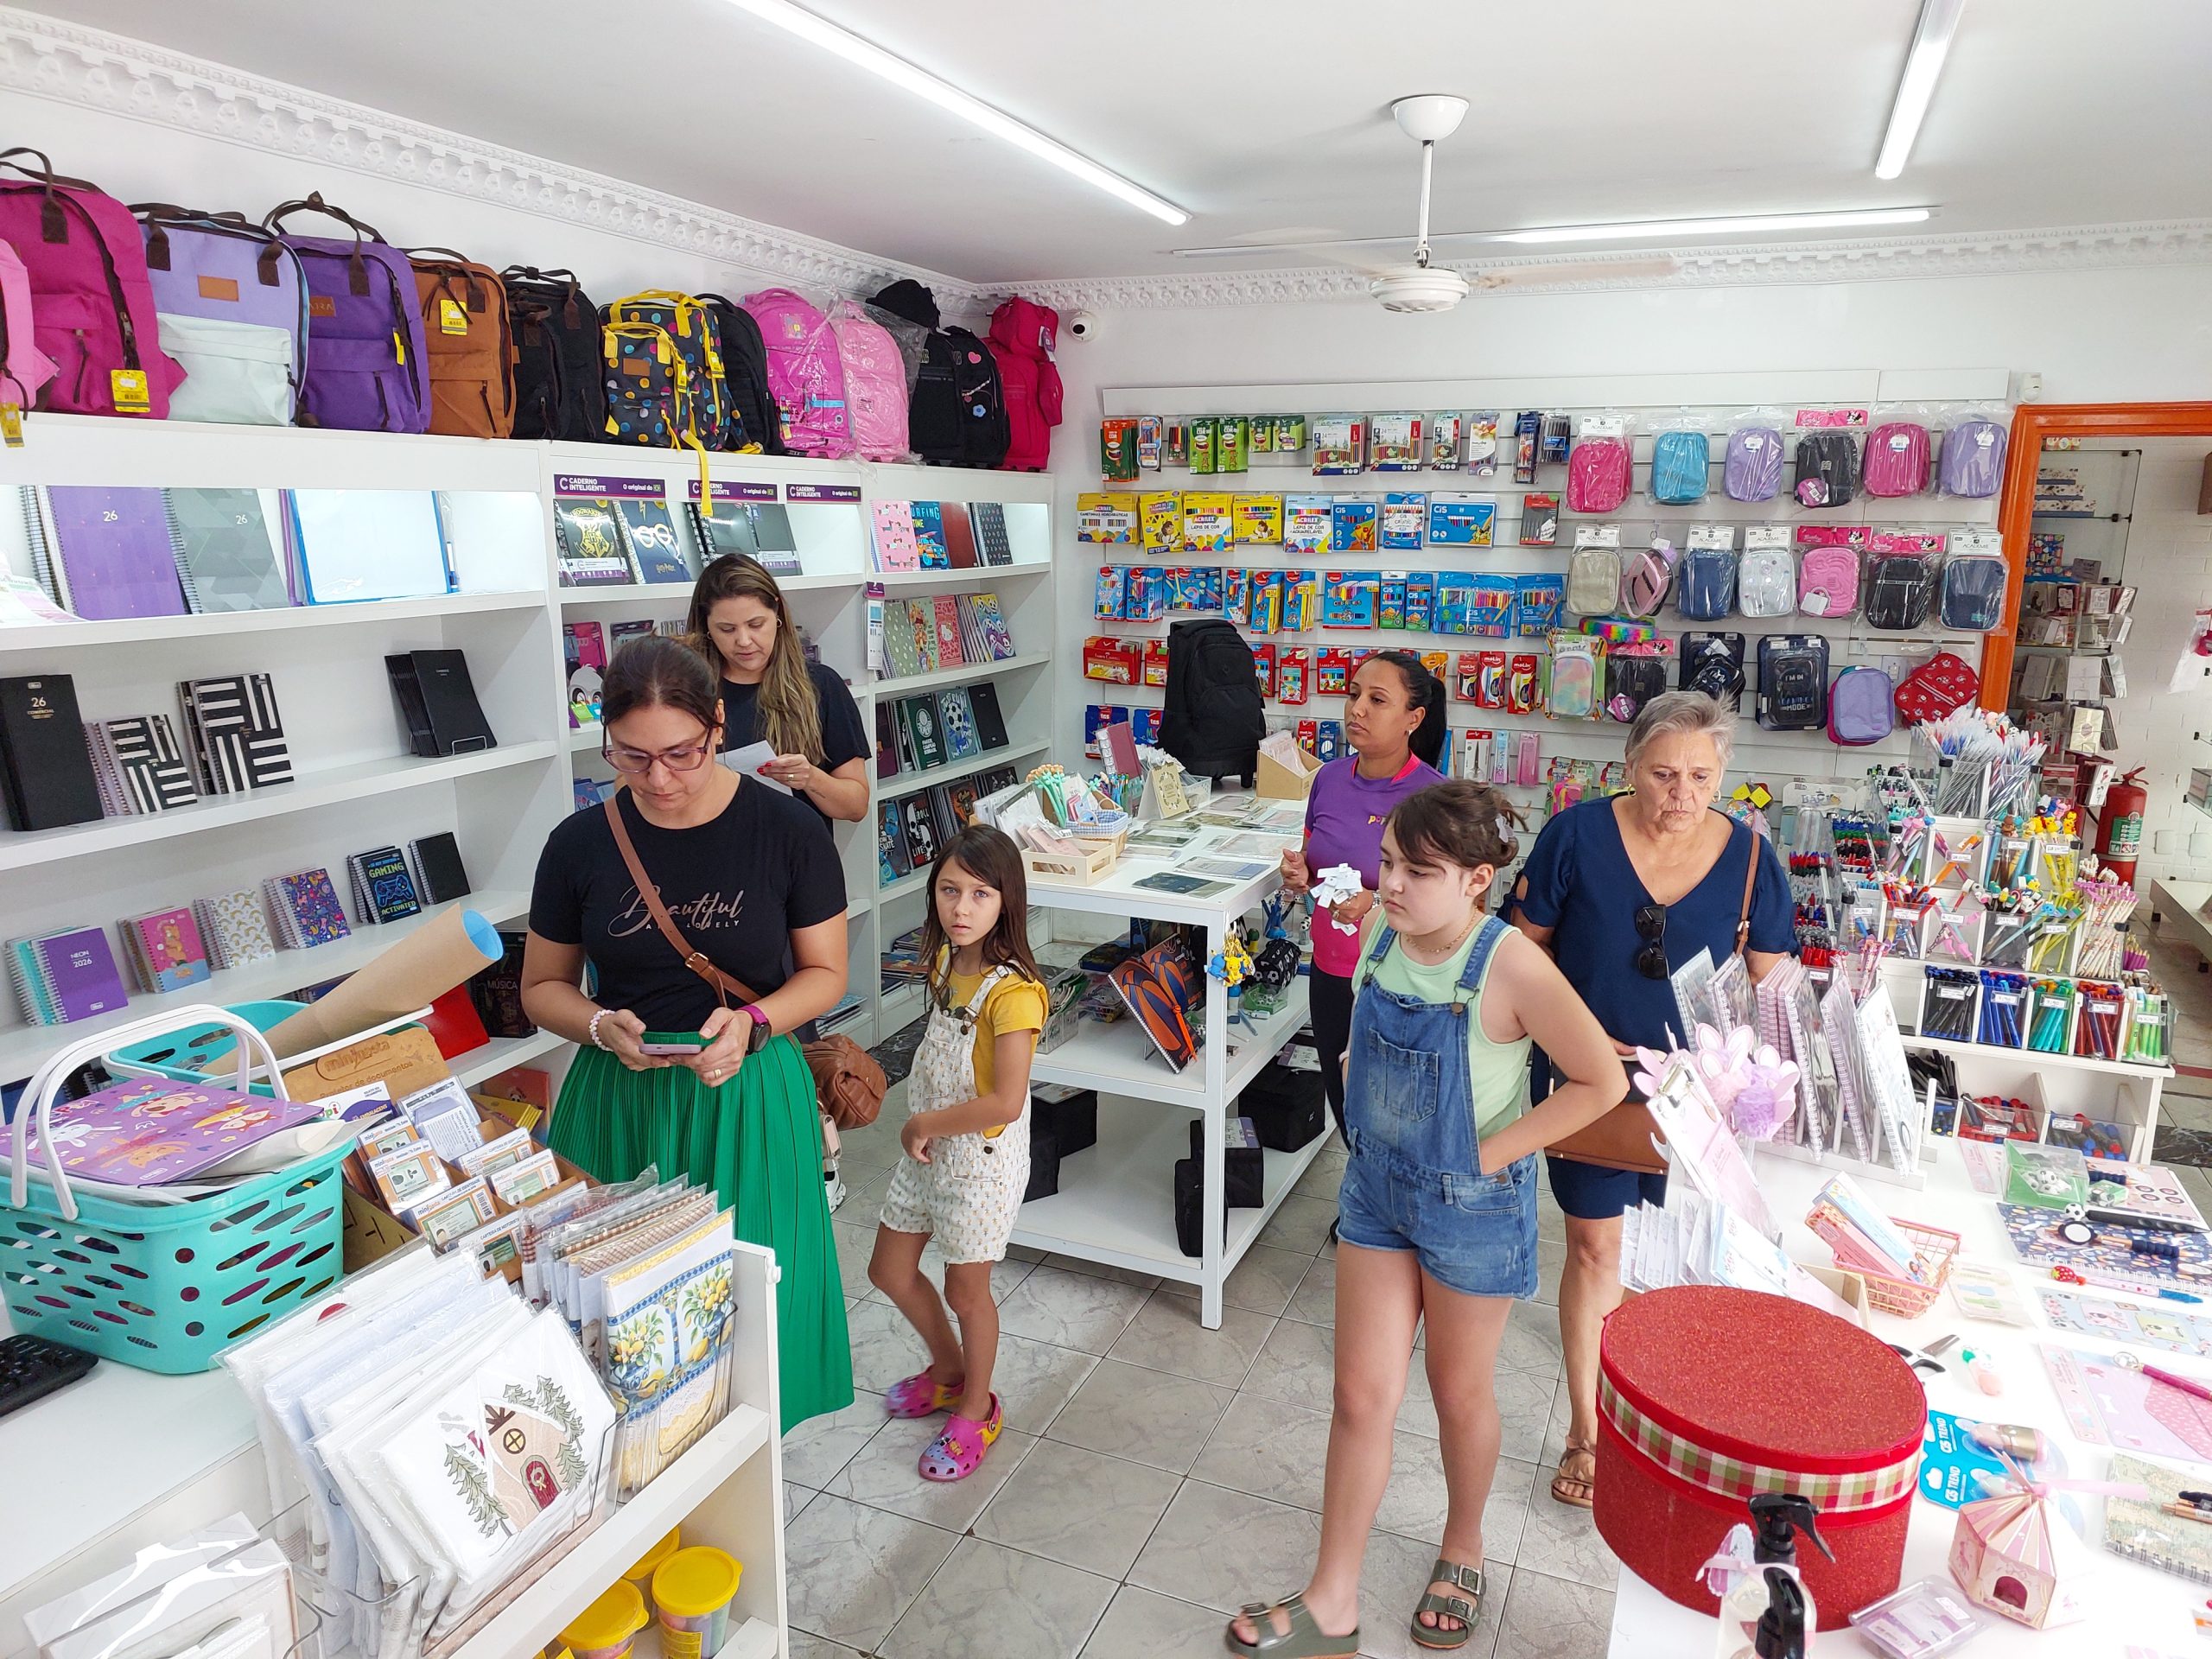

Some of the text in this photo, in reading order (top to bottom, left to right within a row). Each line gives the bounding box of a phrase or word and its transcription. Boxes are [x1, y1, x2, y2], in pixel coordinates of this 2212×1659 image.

[569, 477, 598, 486] CADERNO
[103, 511, 118, 522] 26
[236, 514, 248, 524] 26
[31, 696, 47, 708] 26
[369, 862, 404, 878] GAMING
[381, 900, 416, 915] ACTIVATED
[70, 950, 90, 959] NEON
[73, 958, 92, 969] 2026
[486, 978, 518, 990] MÚSICA
[354, 1077, 365, 1087] de
[366, 1061, 413, 1082] documentos
[1936, 1417, 1949, 1440] TREND
[1947, 1465, 1961, 1489] TREND
